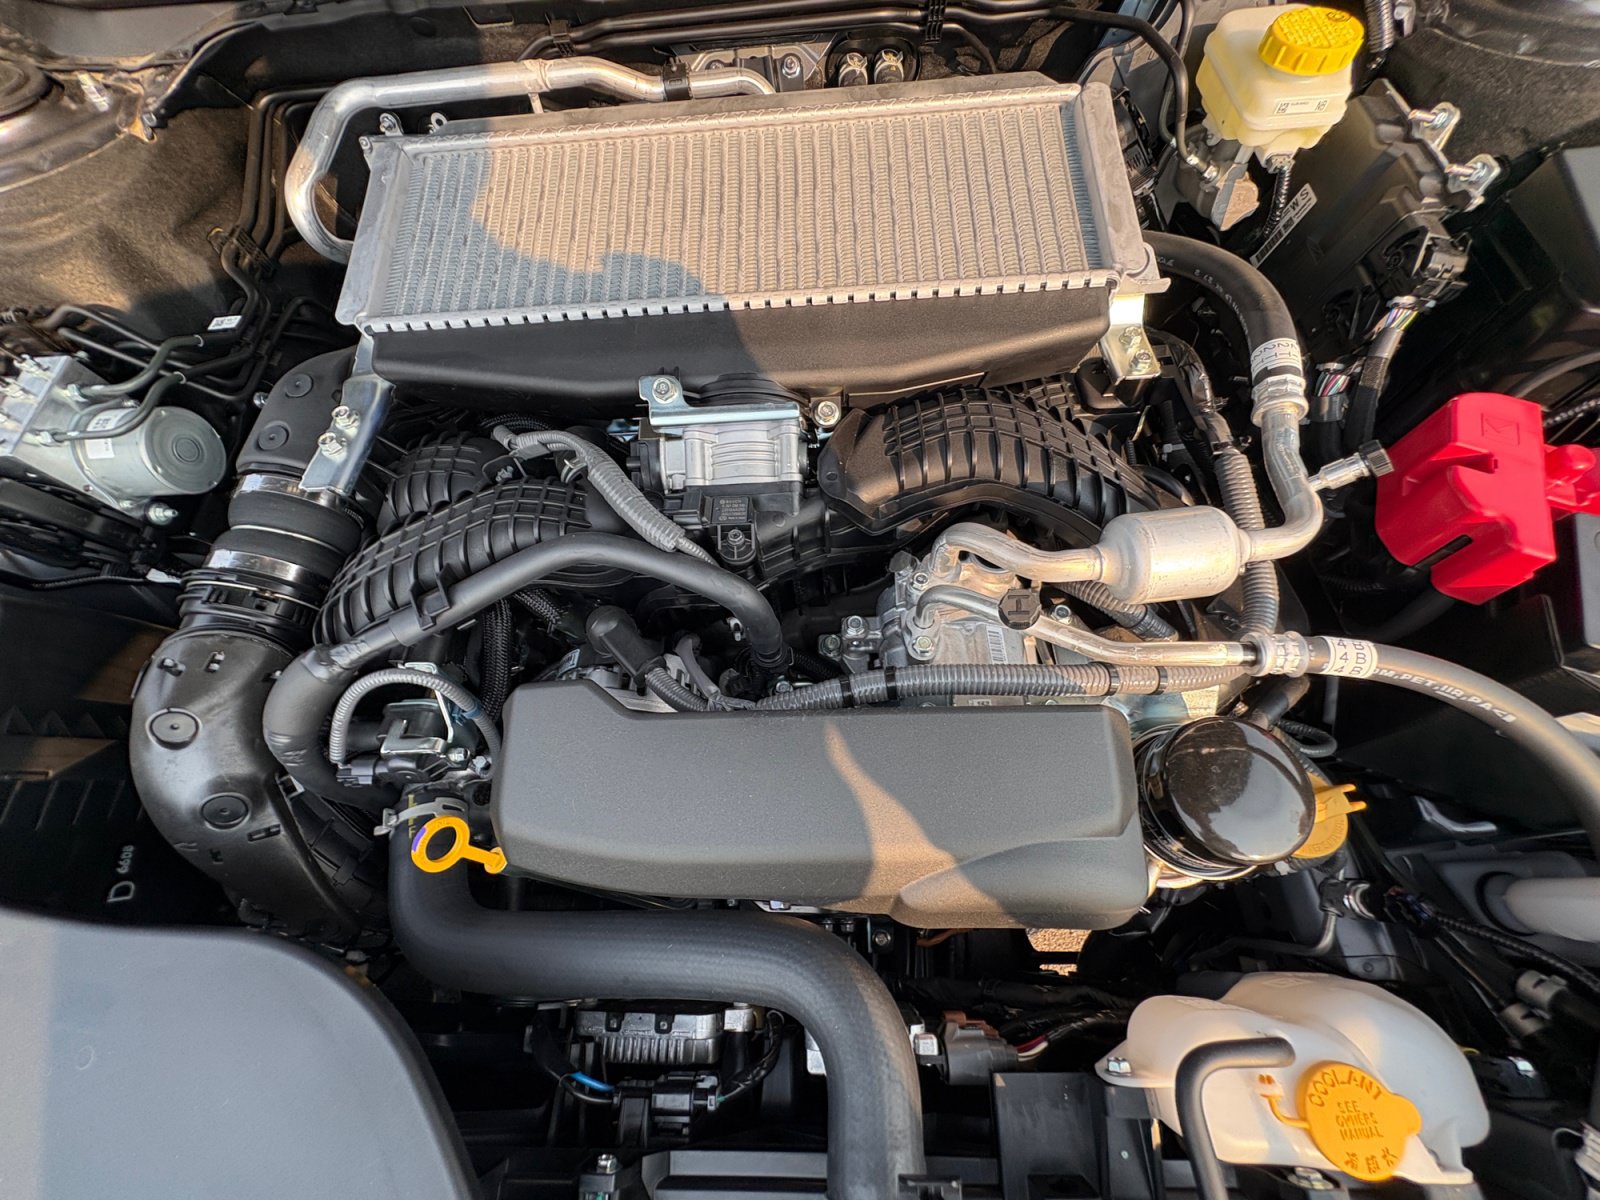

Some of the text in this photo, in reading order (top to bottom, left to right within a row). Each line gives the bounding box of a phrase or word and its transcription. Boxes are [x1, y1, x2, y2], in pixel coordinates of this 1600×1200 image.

[1308, 1069, 1383, 1107] COOLANT
[1336, 1100, 1361, 1113] SEE
[1339, 1126, 1384, 1141] MANUAL
